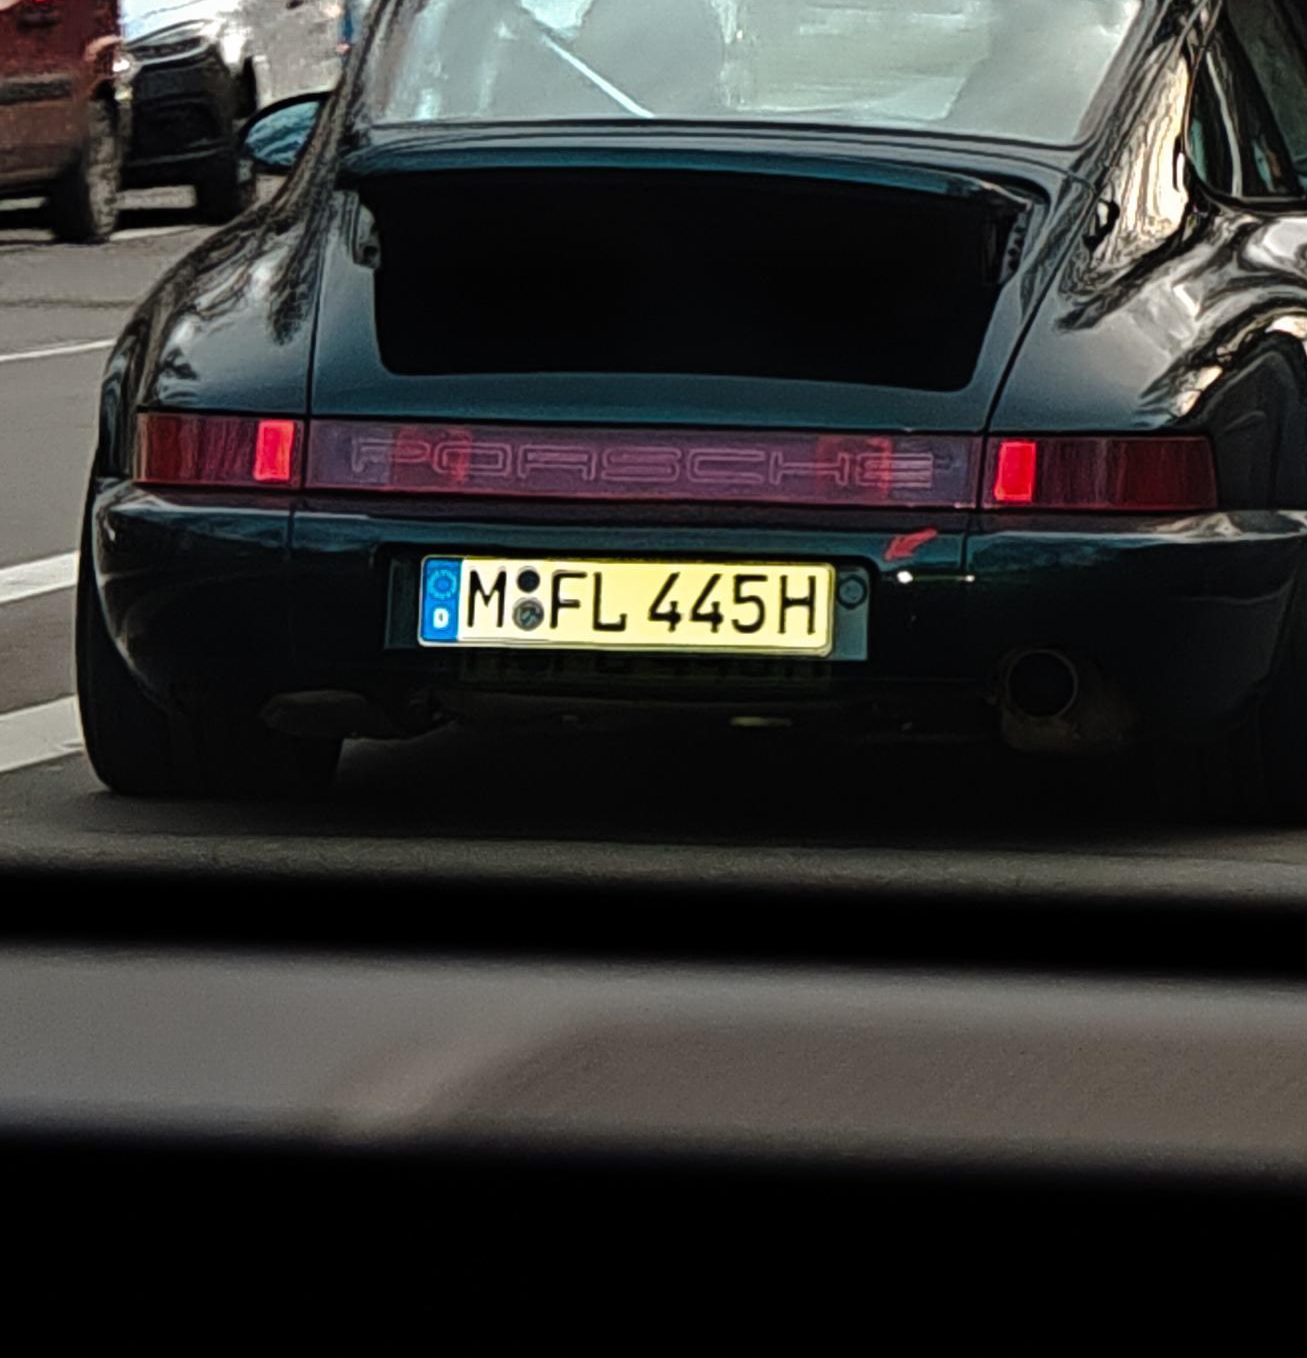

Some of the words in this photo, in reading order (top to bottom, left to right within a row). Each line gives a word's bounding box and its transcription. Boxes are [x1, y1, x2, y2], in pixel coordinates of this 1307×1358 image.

[351, 439, 932, 489] PORSCHE
[466, 568, 507, 628] M
[548, 568, 628, 632] FL
[647, 572, 817, 636] 445H
